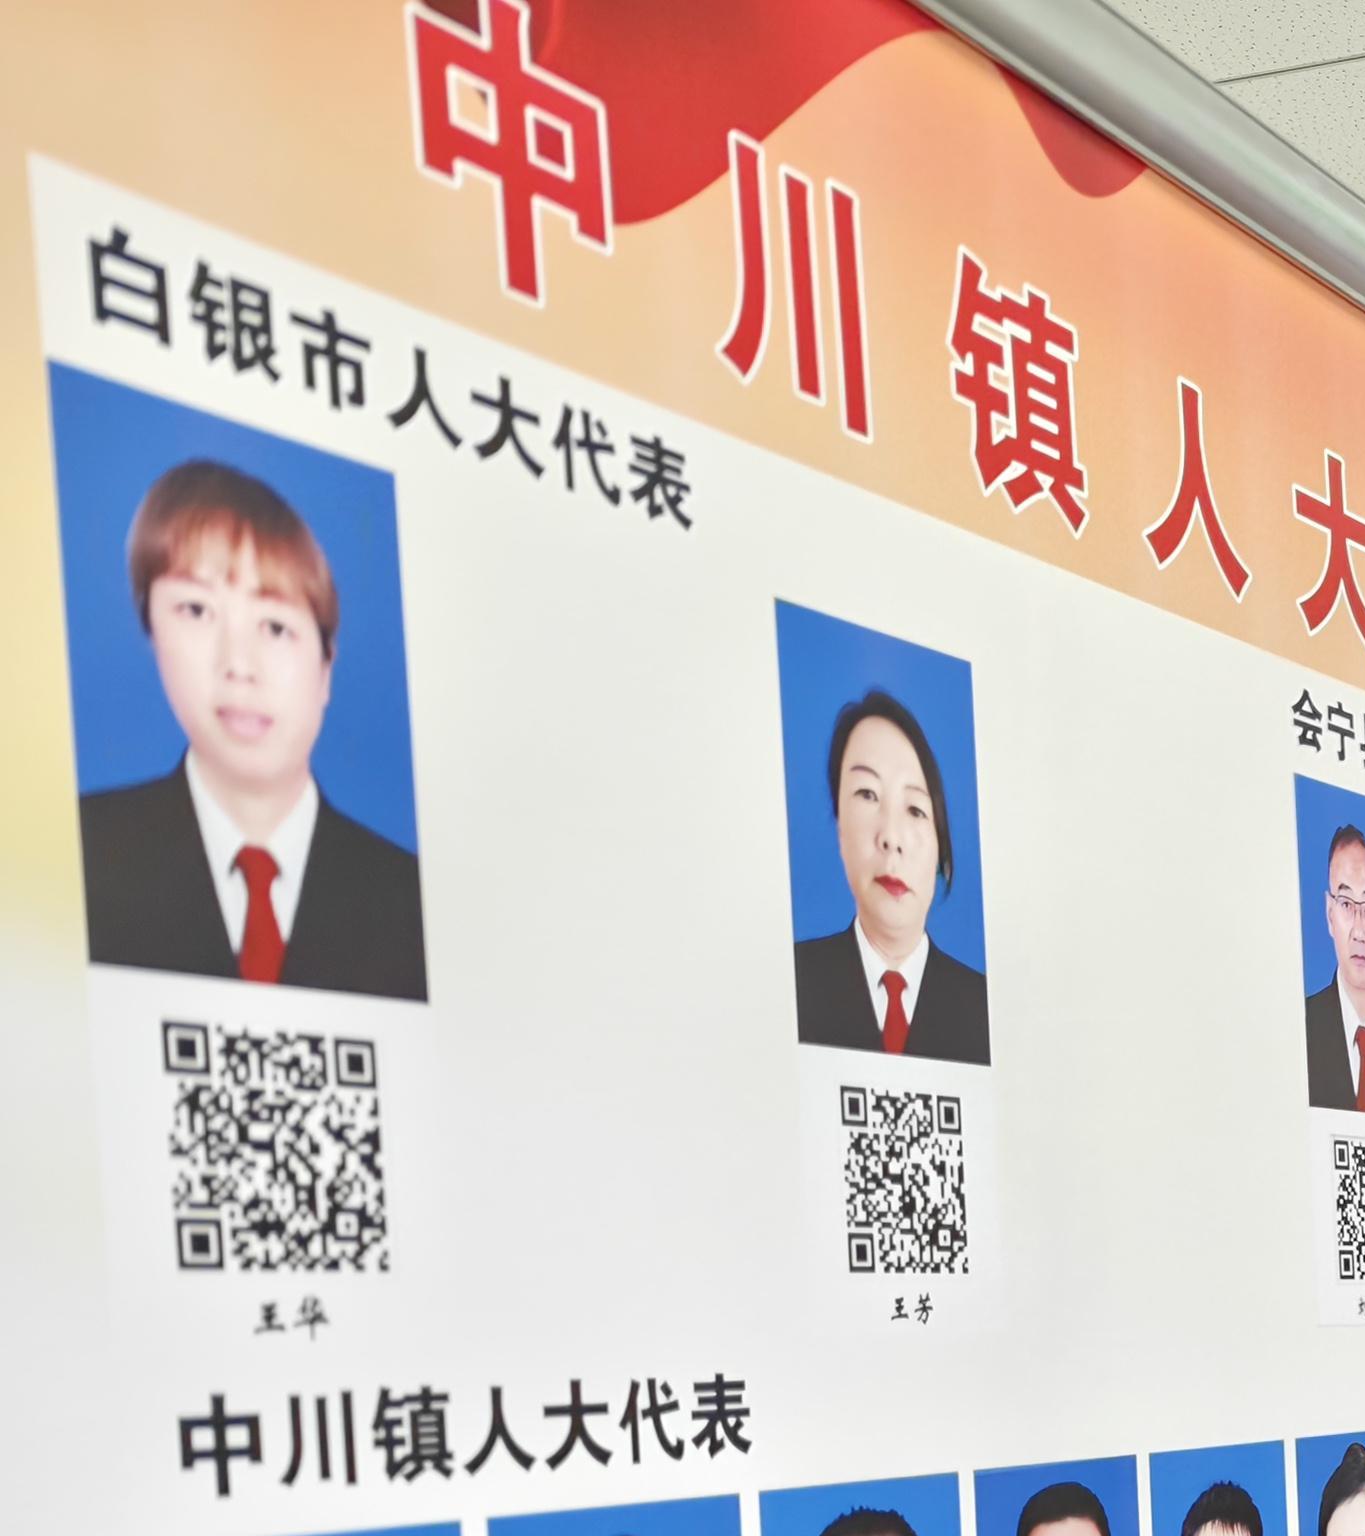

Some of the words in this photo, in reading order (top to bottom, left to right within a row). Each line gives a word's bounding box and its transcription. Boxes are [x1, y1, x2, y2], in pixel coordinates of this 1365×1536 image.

[87, 225, 694, 530] 白银市人大代表
[891, 1292, 933, 1325] 王芳
[177, 1371, 754, 1499] 中川镇人大代表
